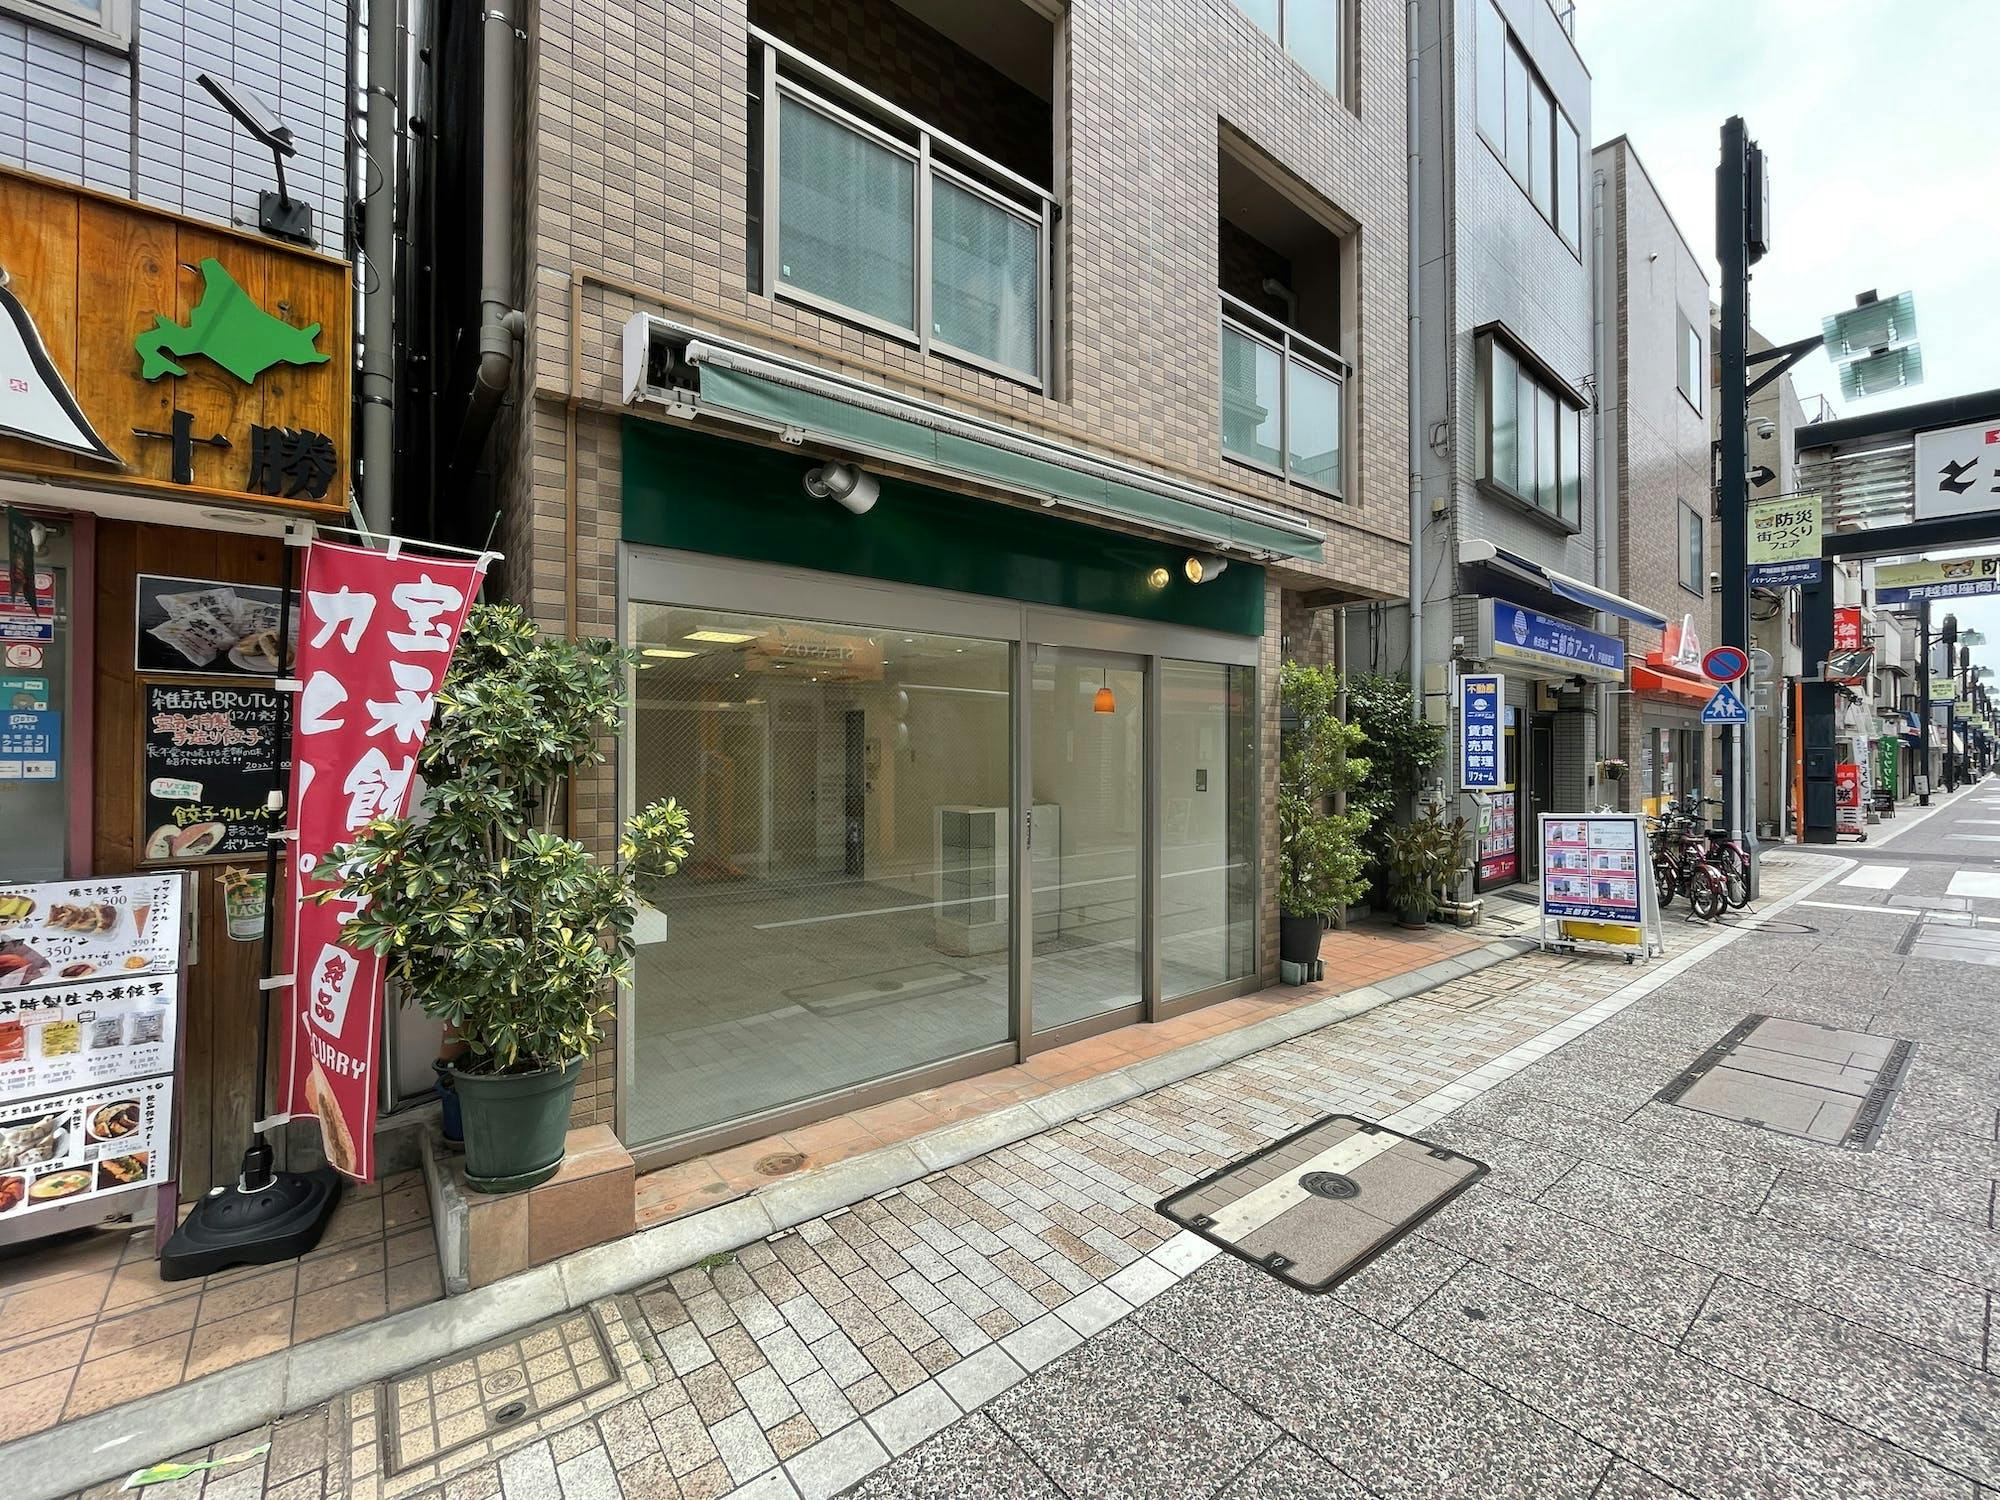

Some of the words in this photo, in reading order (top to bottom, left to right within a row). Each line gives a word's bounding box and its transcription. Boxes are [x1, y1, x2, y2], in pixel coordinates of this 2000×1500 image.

[131, 409, 338, 499] 十勝
[1775, 509, 1813, 528] 防災
[1756, 524, 1812, 542] 街づくり
[1768, 539, 1800, 551] フェア
[1467, 683, 1495, 694] 不動産
[1468, 725, 1494, 736] 賃貸
[1468, 740, 1494, 752] 売買
[1468, 755, 1494, 767] 管理
[1468, 771, 1494, 782] リフォーム
[68, 885, 123, 898] 焼き餃子
[102, 895, 128, 905] 500
[46, 945, 72, 957] 350
[311, 1033, 367, 1080] CURRY
